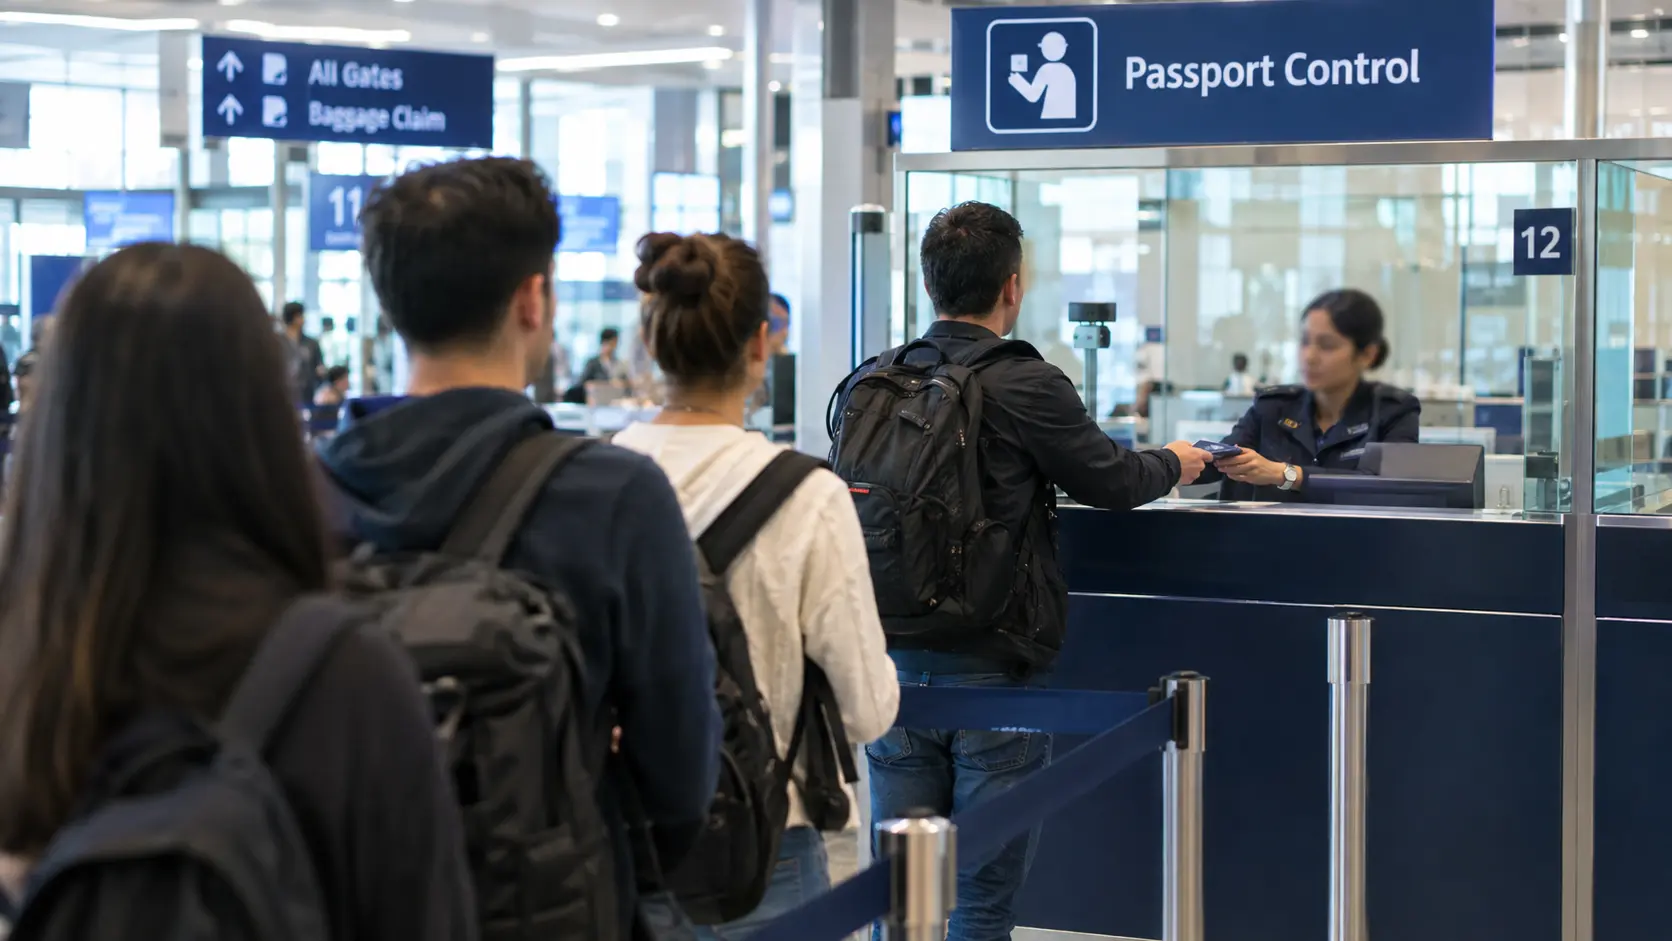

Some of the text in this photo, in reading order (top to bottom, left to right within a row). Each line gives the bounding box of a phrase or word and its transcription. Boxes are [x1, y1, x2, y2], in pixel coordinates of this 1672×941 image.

[308, 59, 403, 91] All Gates
[1126, 48, 1420, 97] Passport Control
[308, 101, 446, 134] Baggage Claim
[328, 185, 362, 227] 11
[1521, 226, 1560, 259] 12
